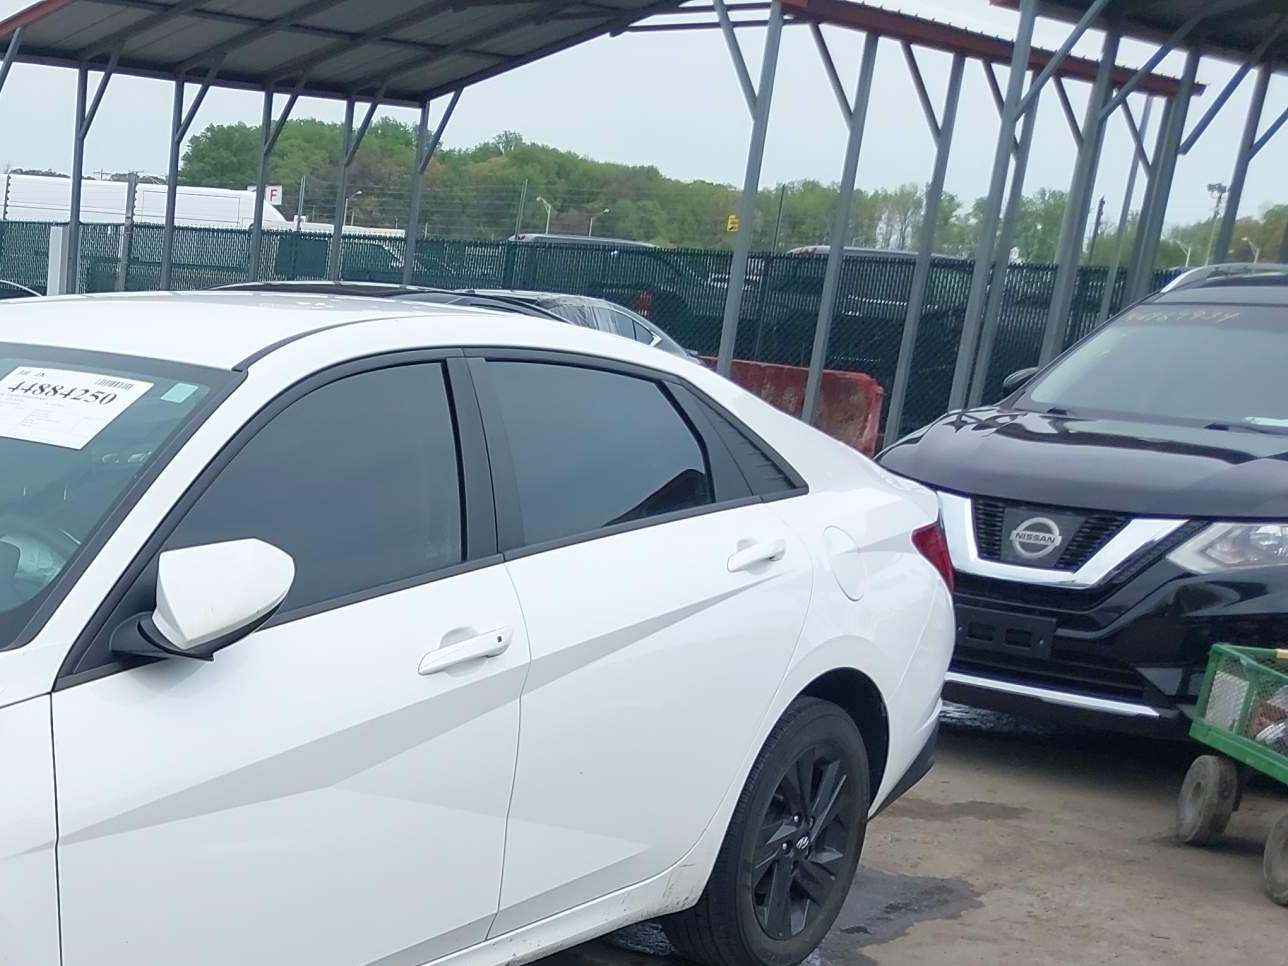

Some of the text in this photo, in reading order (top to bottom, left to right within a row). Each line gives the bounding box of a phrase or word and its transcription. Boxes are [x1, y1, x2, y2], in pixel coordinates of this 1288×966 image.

[269, 189, 278, 202] F
[7, 380, 118, 406] 44884250
[1015, 532, 1056, 544] NISSAN
